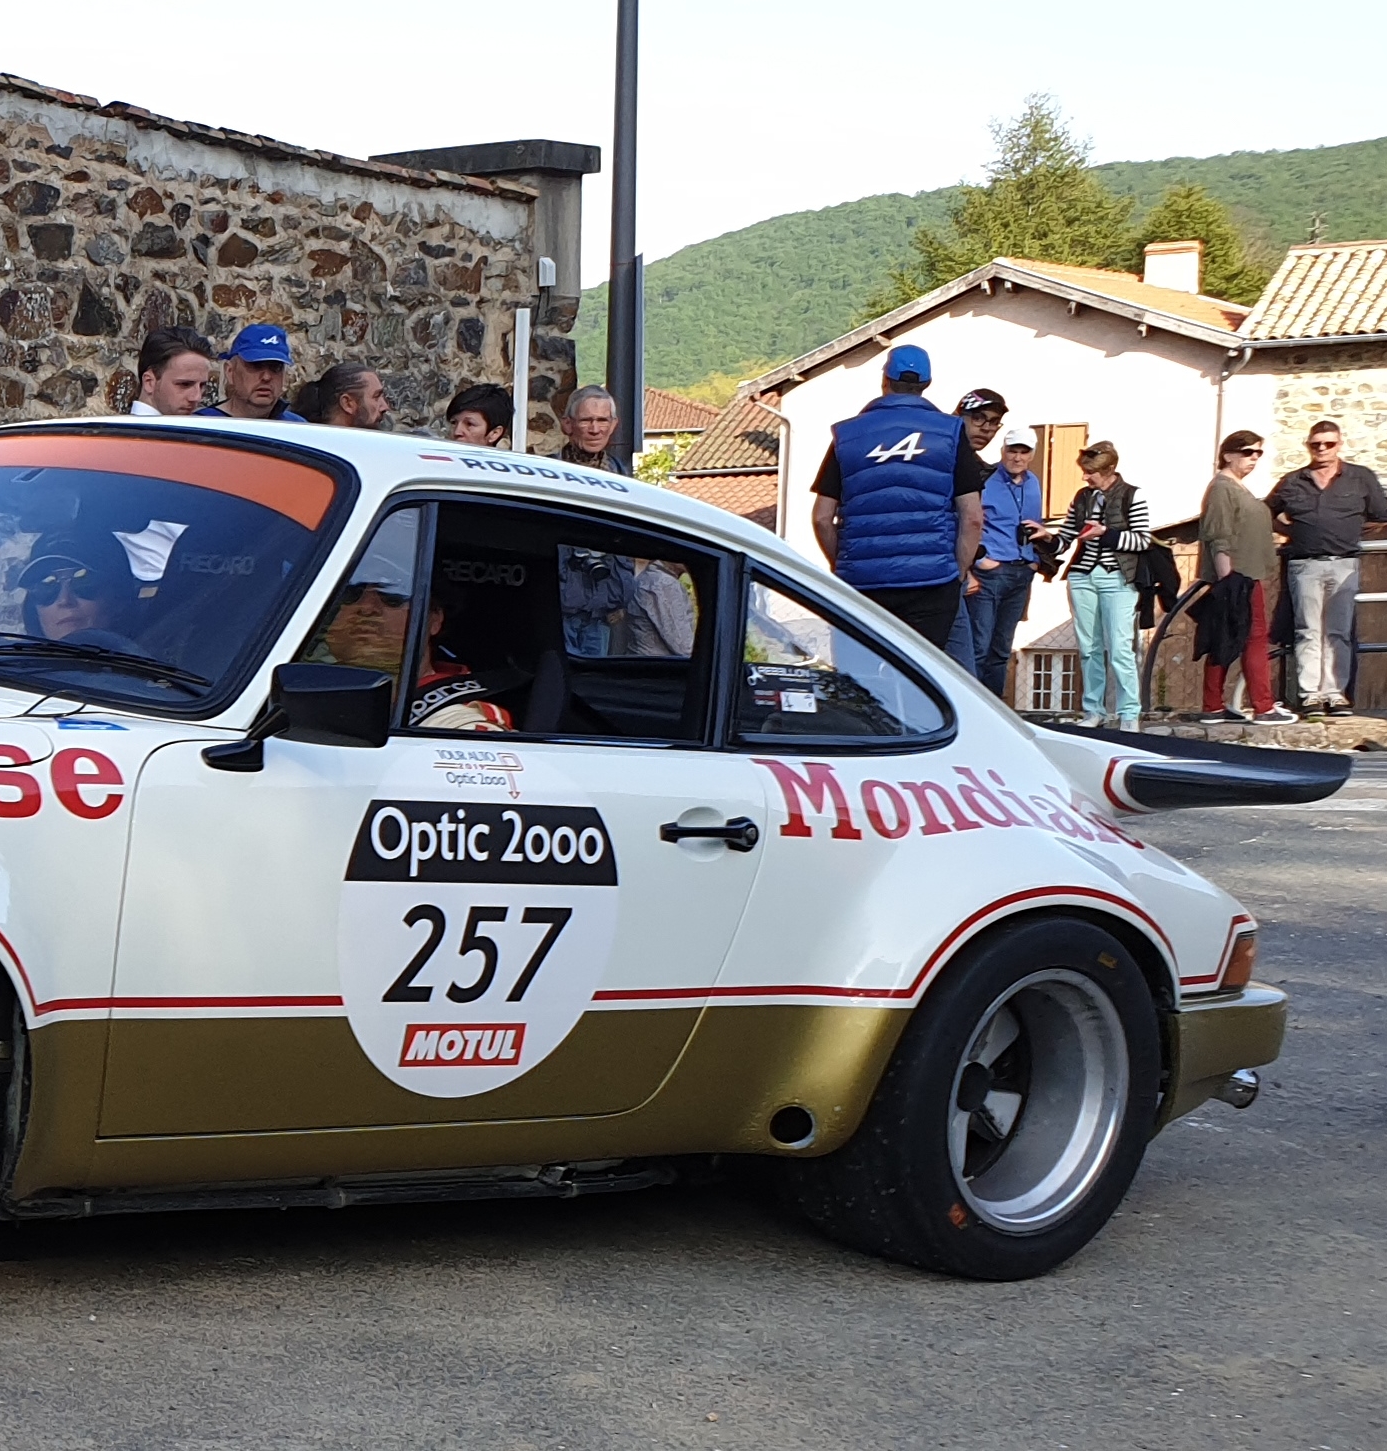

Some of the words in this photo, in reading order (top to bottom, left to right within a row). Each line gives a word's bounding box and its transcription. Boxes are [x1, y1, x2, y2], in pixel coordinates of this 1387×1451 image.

[410, 680, 482, 720] parco
[446, 771, 477, 788] Optic
[477, 772, 507, 786] 2000
[370, 805, 490, 877] Optic
[500, 810, 604, 865] 2000
[381, 904, 574, 1004] 257
[405, 1028, 517, 1061] MOTUL
